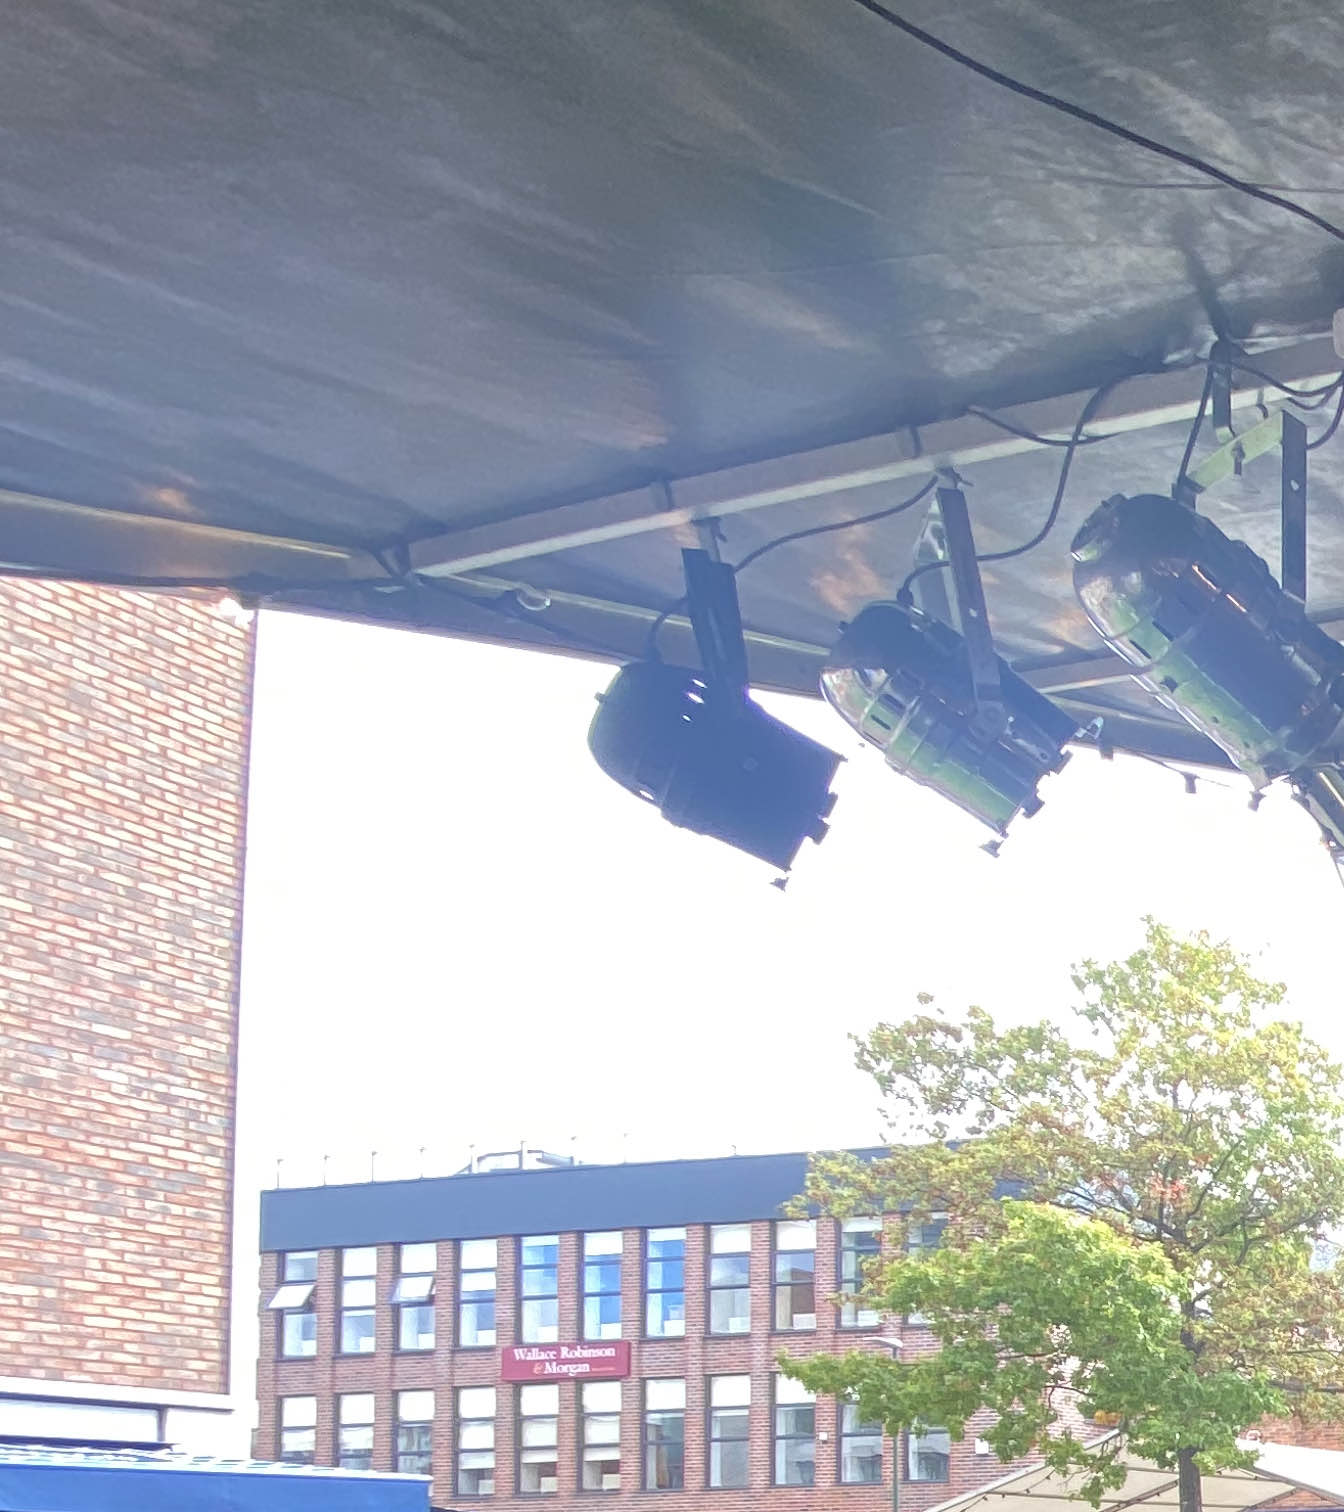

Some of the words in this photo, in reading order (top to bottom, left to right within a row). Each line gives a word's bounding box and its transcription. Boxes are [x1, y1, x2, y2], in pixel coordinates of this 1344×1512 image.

[513, 1348, 557, 1361] Wallace
[560, 1345, 616, 1359] Robinson
[544, 1362, 590, 1376] Morgan
